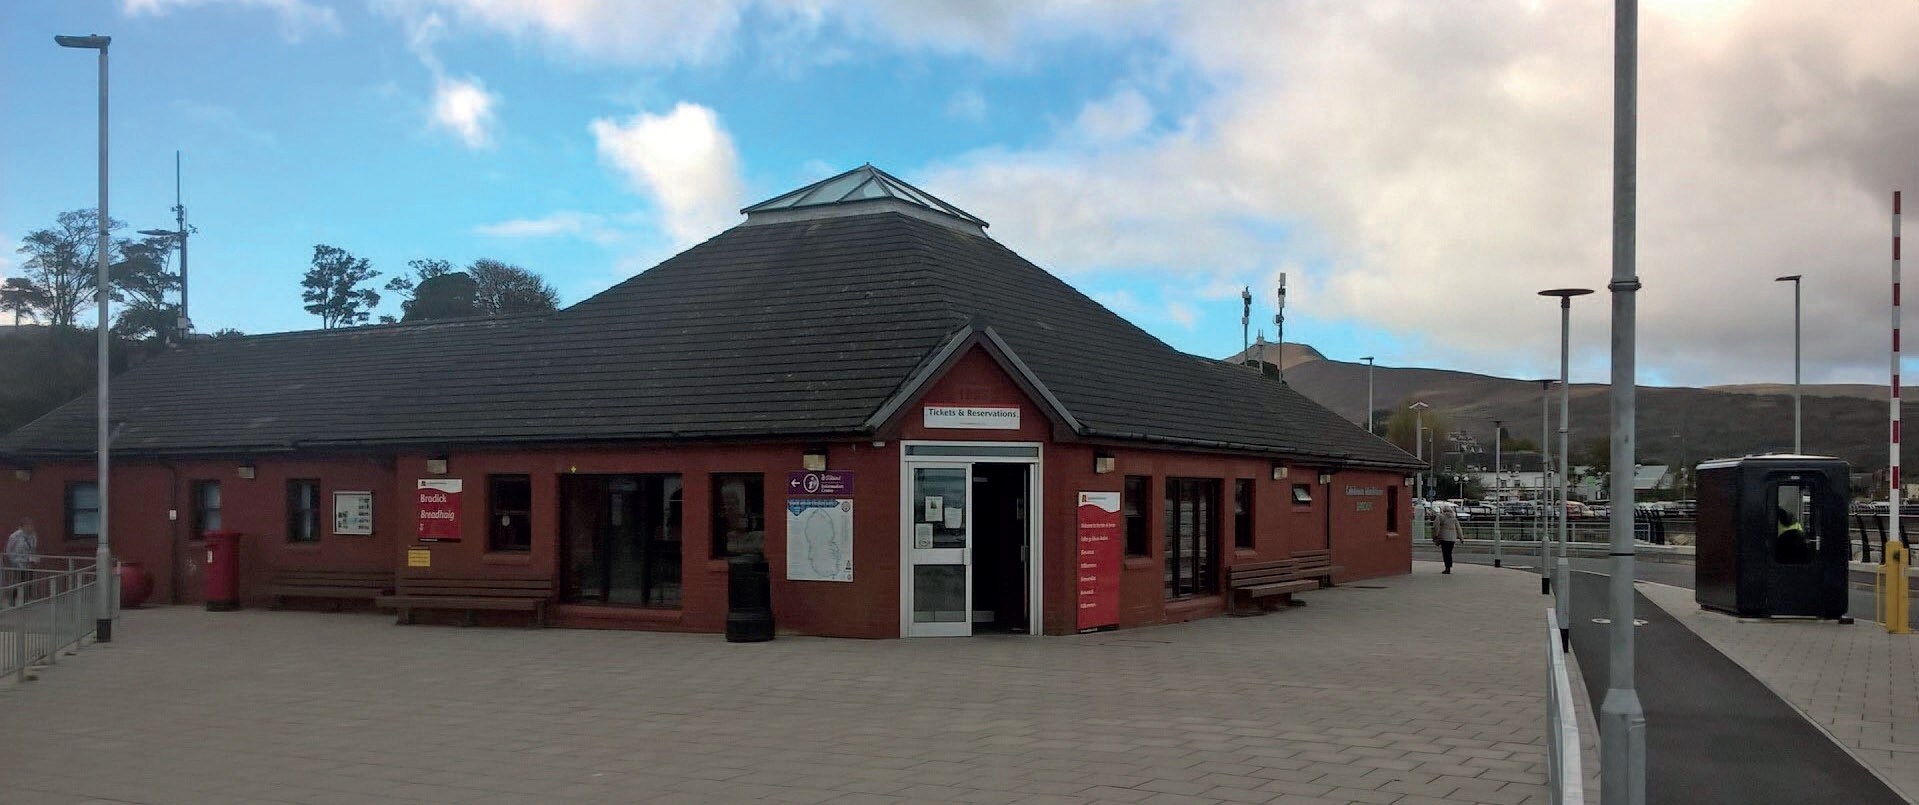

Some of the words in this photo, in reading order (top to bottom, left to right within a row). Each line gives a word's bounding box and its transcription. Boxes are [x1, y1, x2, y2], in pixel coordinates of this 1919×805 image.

[928, 408, 956, 417] Tickets
[958, 409, 965, 417] &
[967, 409, 1017, 418] Reservations
[420, 494, 447, 503] Brodick
[420, 510, 455, 521] Breadhaig
